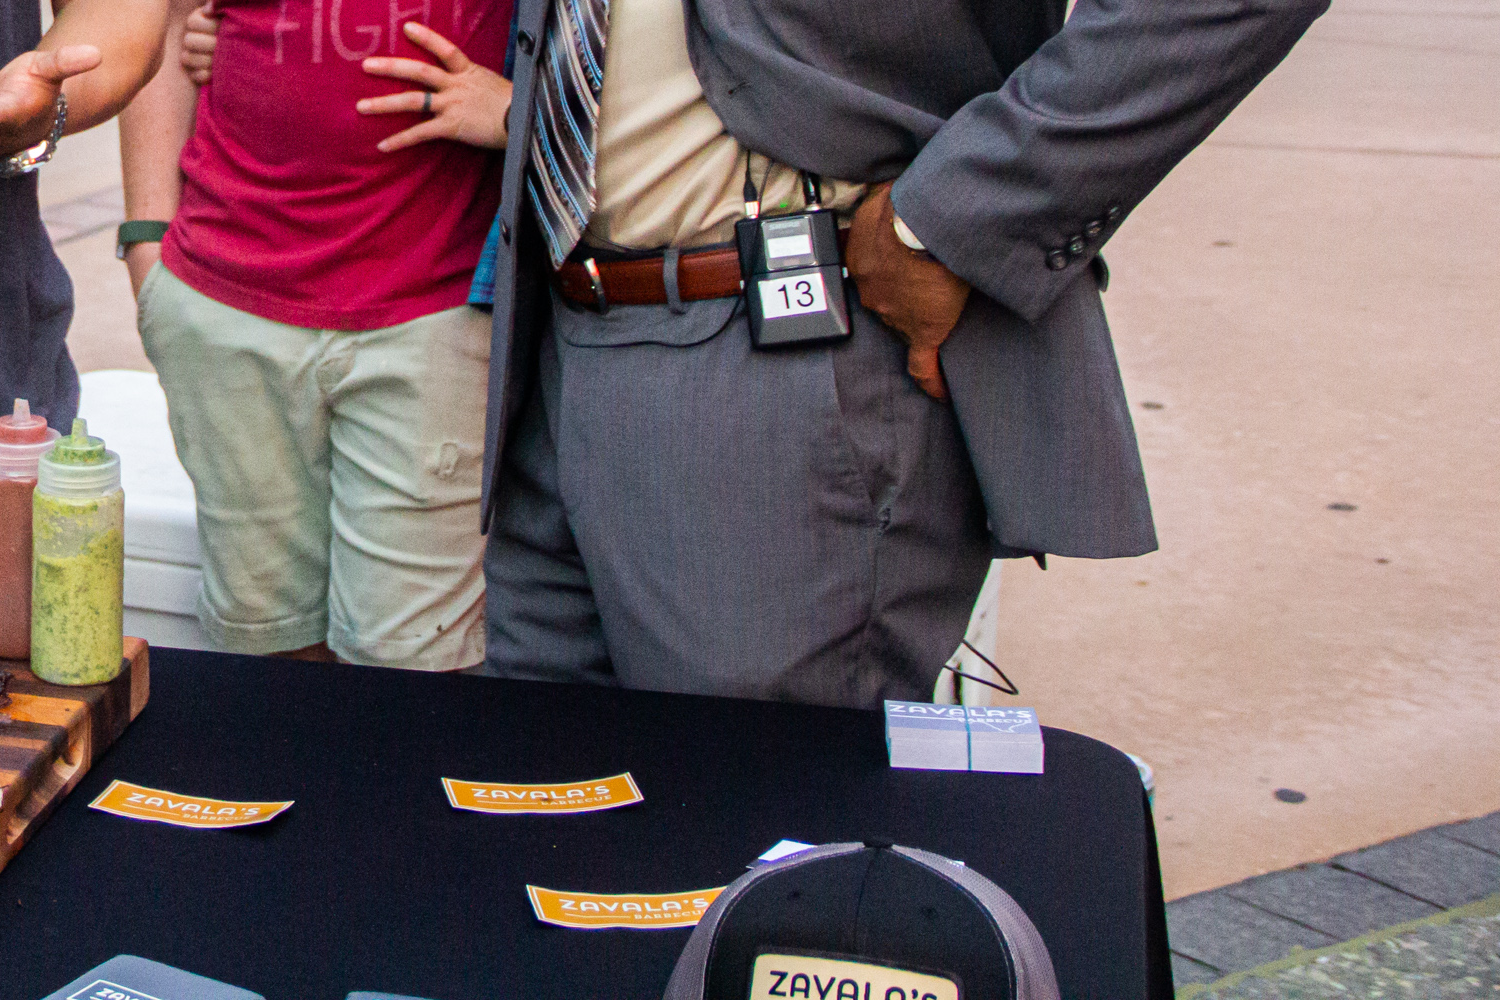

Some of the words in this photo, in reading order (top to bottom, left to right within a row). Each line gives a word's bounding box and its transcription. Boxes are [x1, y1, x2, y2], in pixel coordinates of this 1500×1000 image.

[777, 280, 815, 310] 13
[888, 704, 1033, 719] ZAVALA'S
[471, 784, 610, 800] ZAVALA'S
[125, 791, 261, 817] ZAVALA'S
[181, 813, 254, 822] BARBECUE
[558, 897, 709, 913] ZAVALA'S
[633, 908, 705, 920] BARBECU
